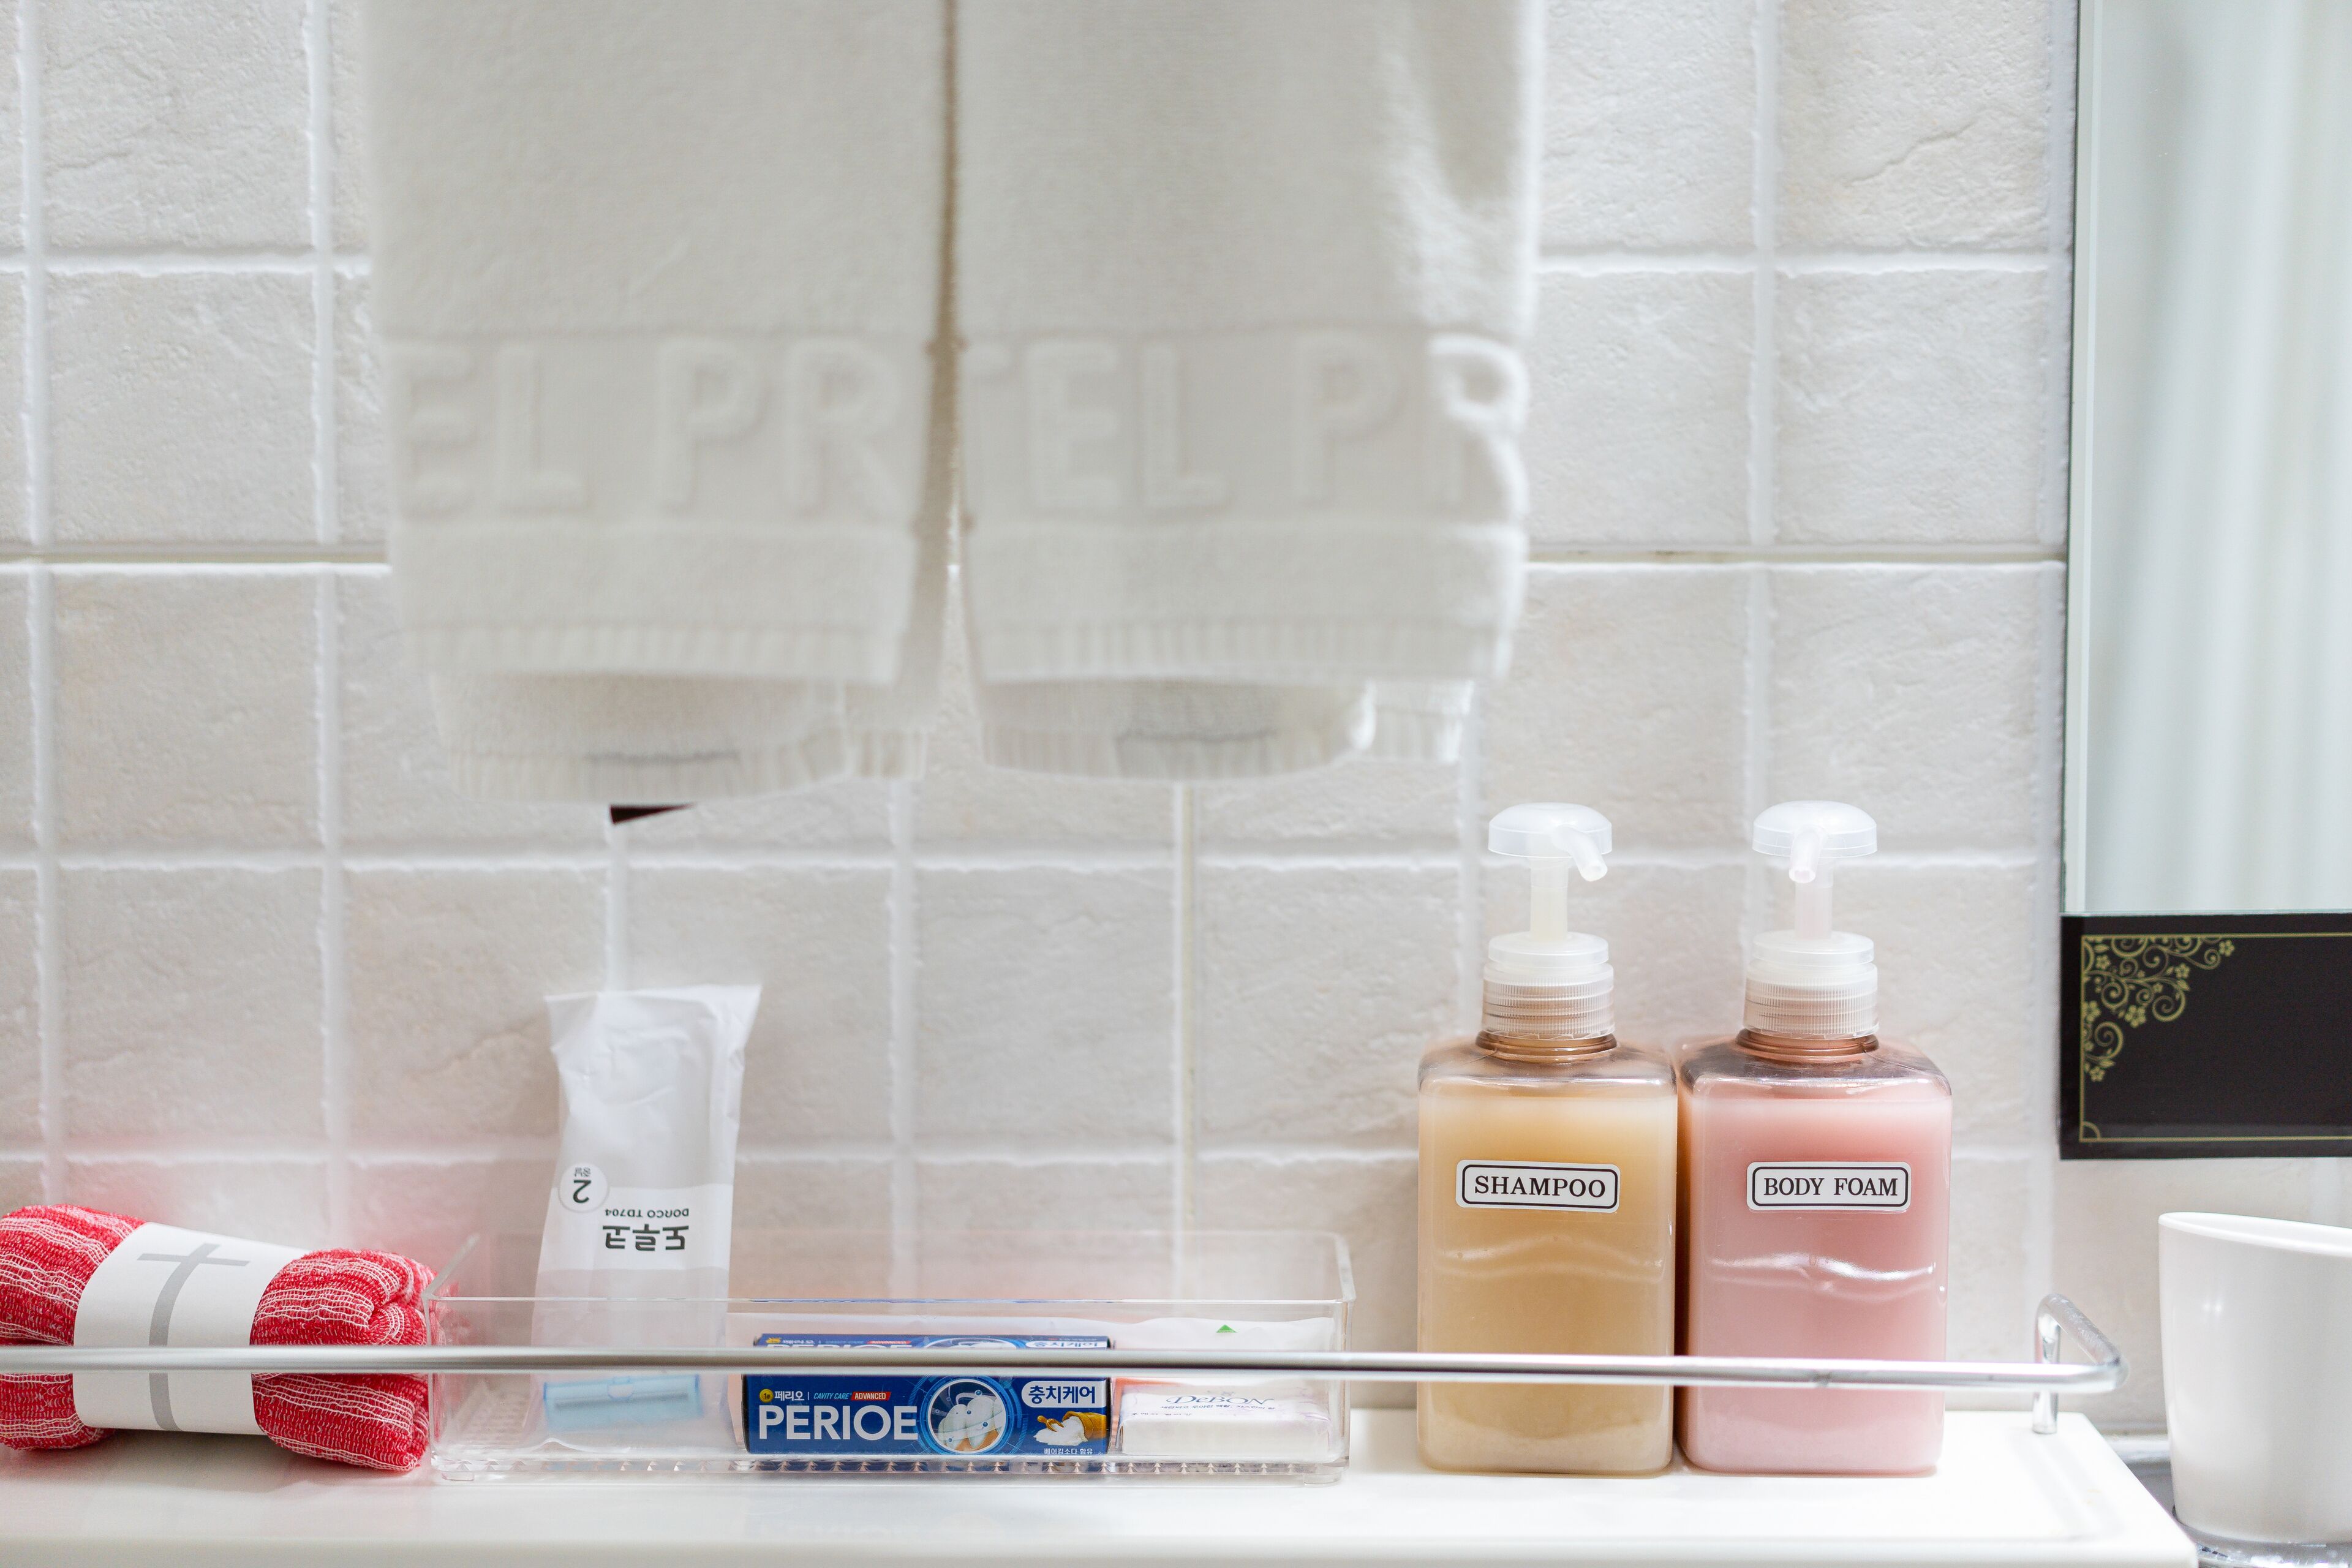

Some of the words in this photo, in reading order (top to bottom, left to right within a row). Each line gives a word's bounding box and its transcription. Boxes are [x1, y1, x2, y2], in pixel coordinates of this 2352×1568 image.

[655, 337, 913, 516] PR
[573, 1179, 592, 1205] 2
[1474, 1175, 1607, 1198] SHAMPOO
[1764, 1177, 1825, 1197] BODY
[1834, 1178, 1898, 1197] FOAM
[605, 1208, 644, 1218] TD704
[647, 1208, 690, 1218] DORCO
[602, 1224, 690, 1252] 도루코
[774, 1390, 805, 1401] 페리오
[1028, 1385, 1096, 1404] 충치케어
[759, 1404, 918, 1441] PERIOE
